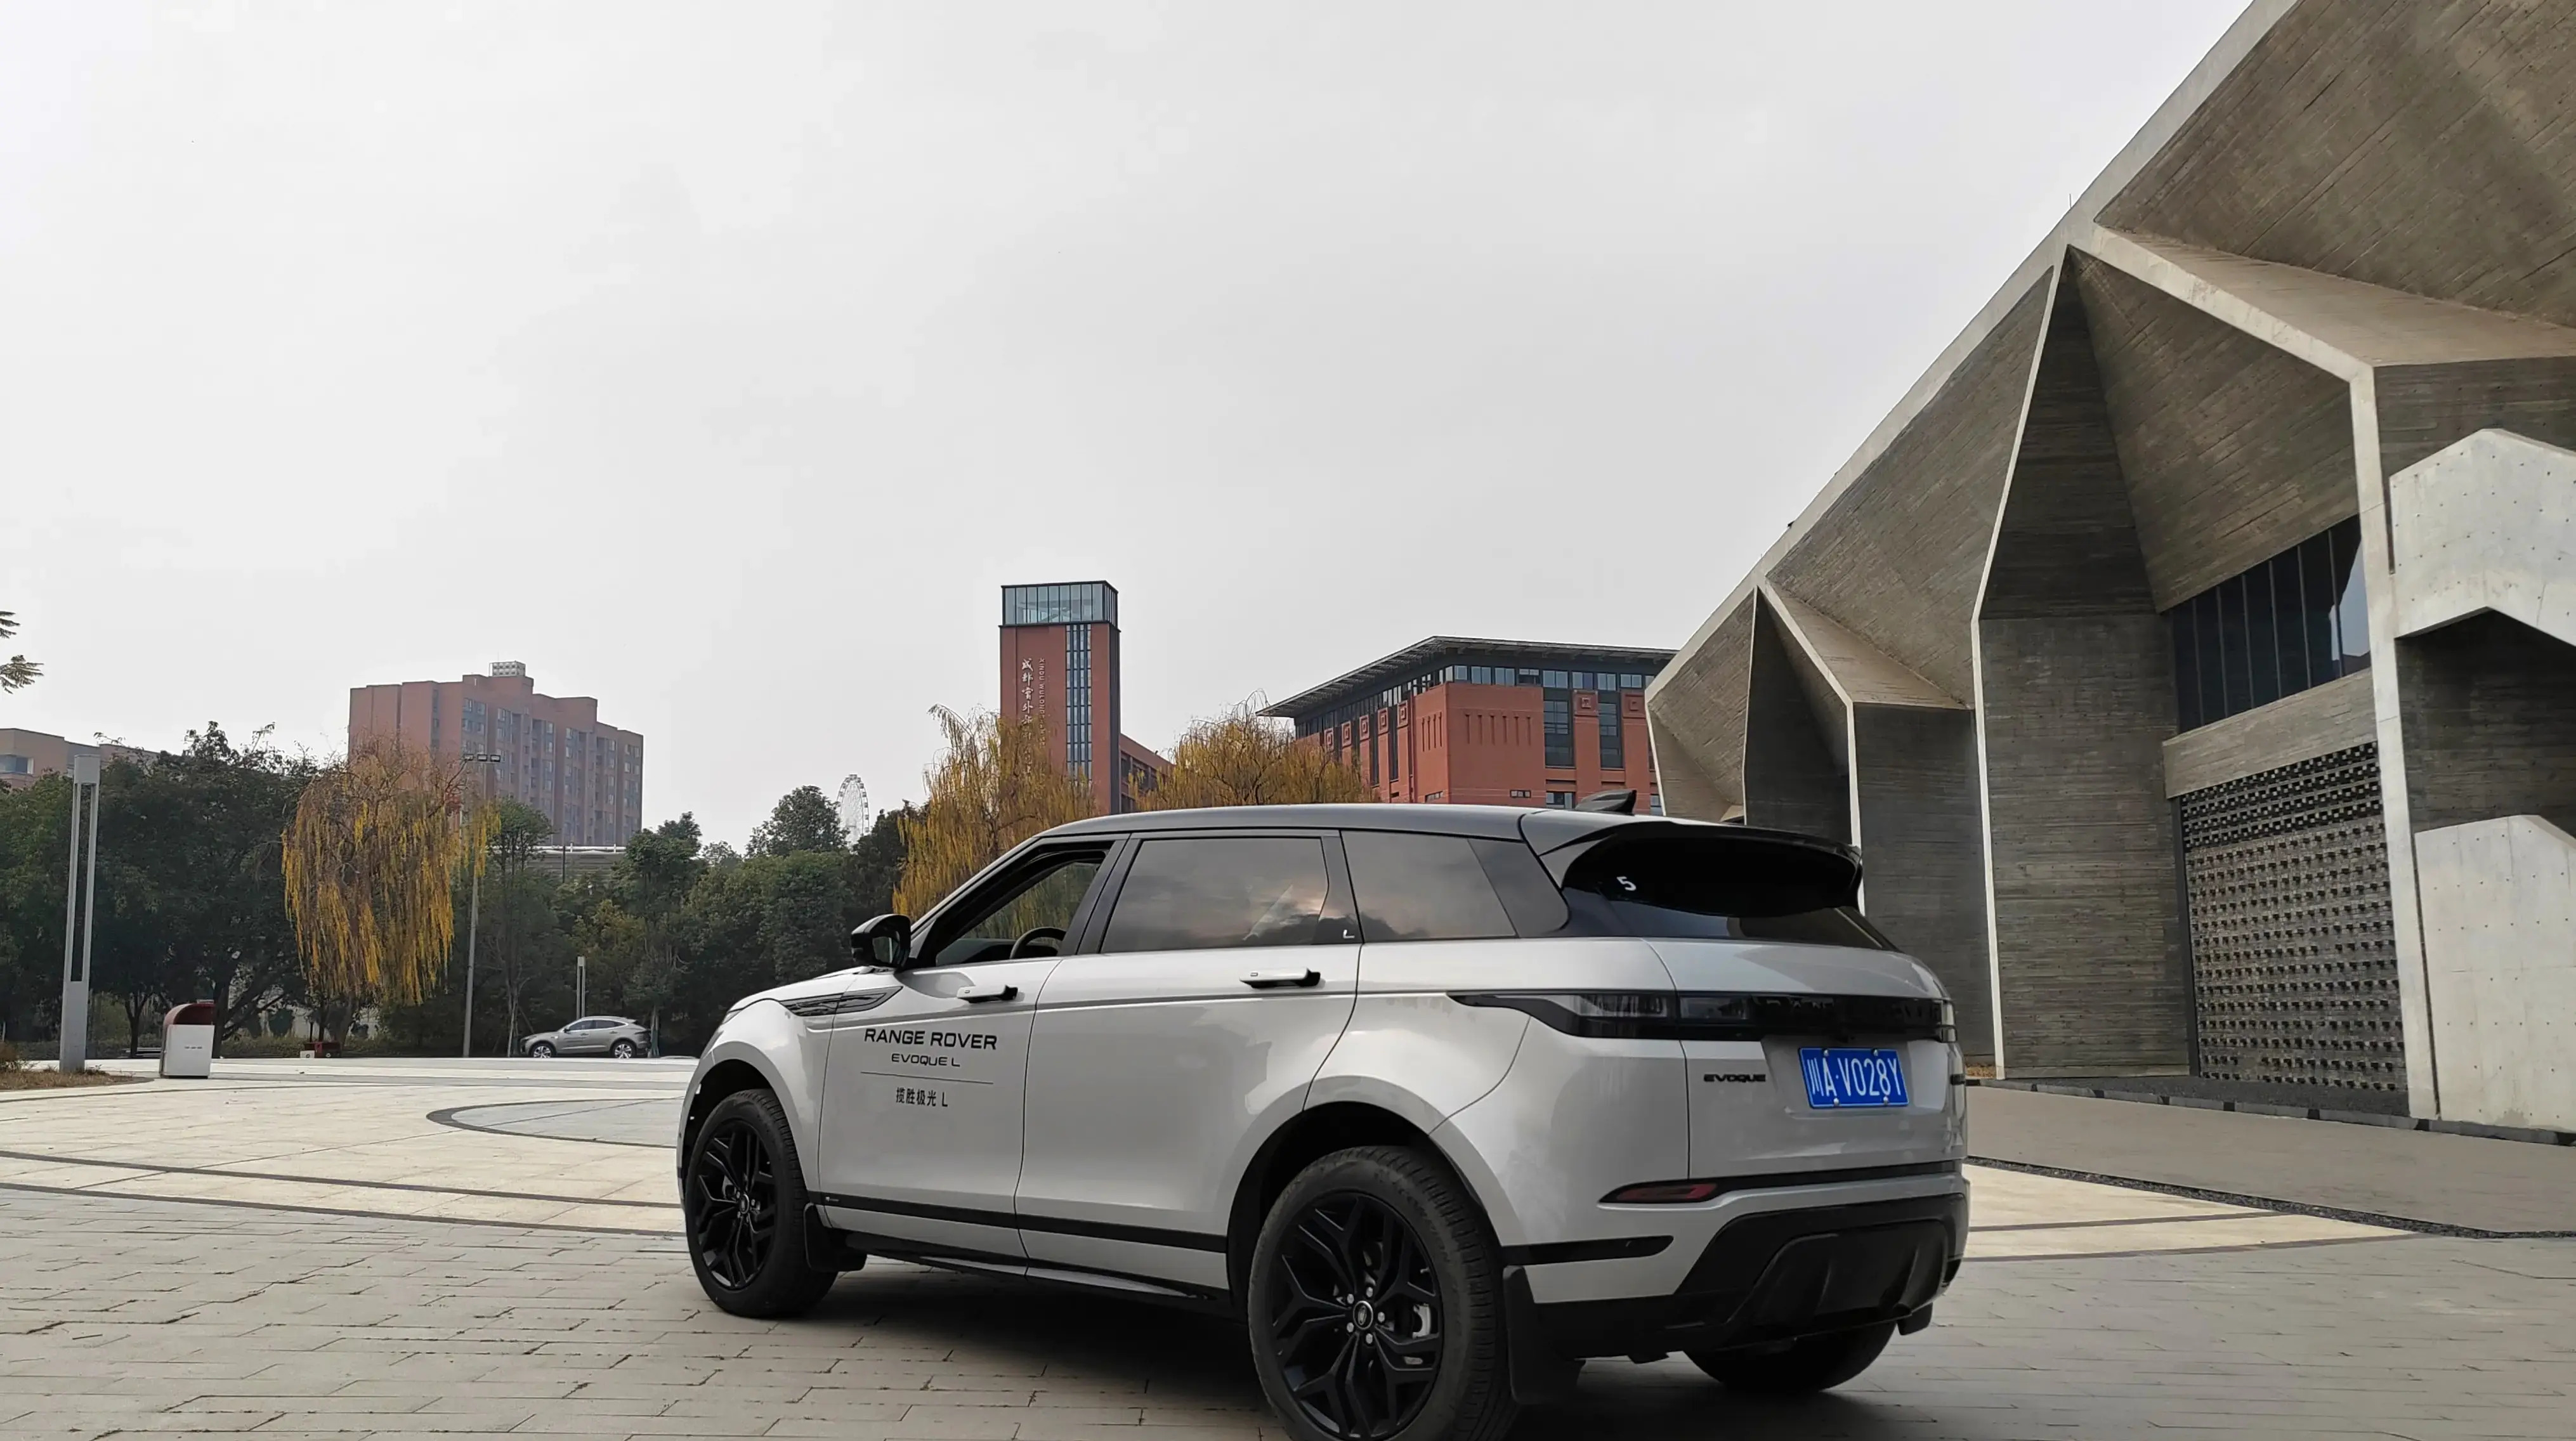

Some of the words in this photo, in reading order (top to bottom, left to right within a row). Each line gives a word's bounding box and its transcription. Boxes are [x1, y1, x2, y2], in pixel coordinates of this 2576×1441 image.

[1616, 876, 1637, 891] 5
[864, 1028, 926, 1045] RANGE
[930, 1031, 998, 1050] ROVER
[891, 1053, 948, 1066] EVOQUE
[951, 1057, 961, 1067] L
[1703, 1073, 1766, 1083] EVOQUE
[896, 1086, 937, 1107] 揽胜极光
[941, 1092, 948, 1107] L
